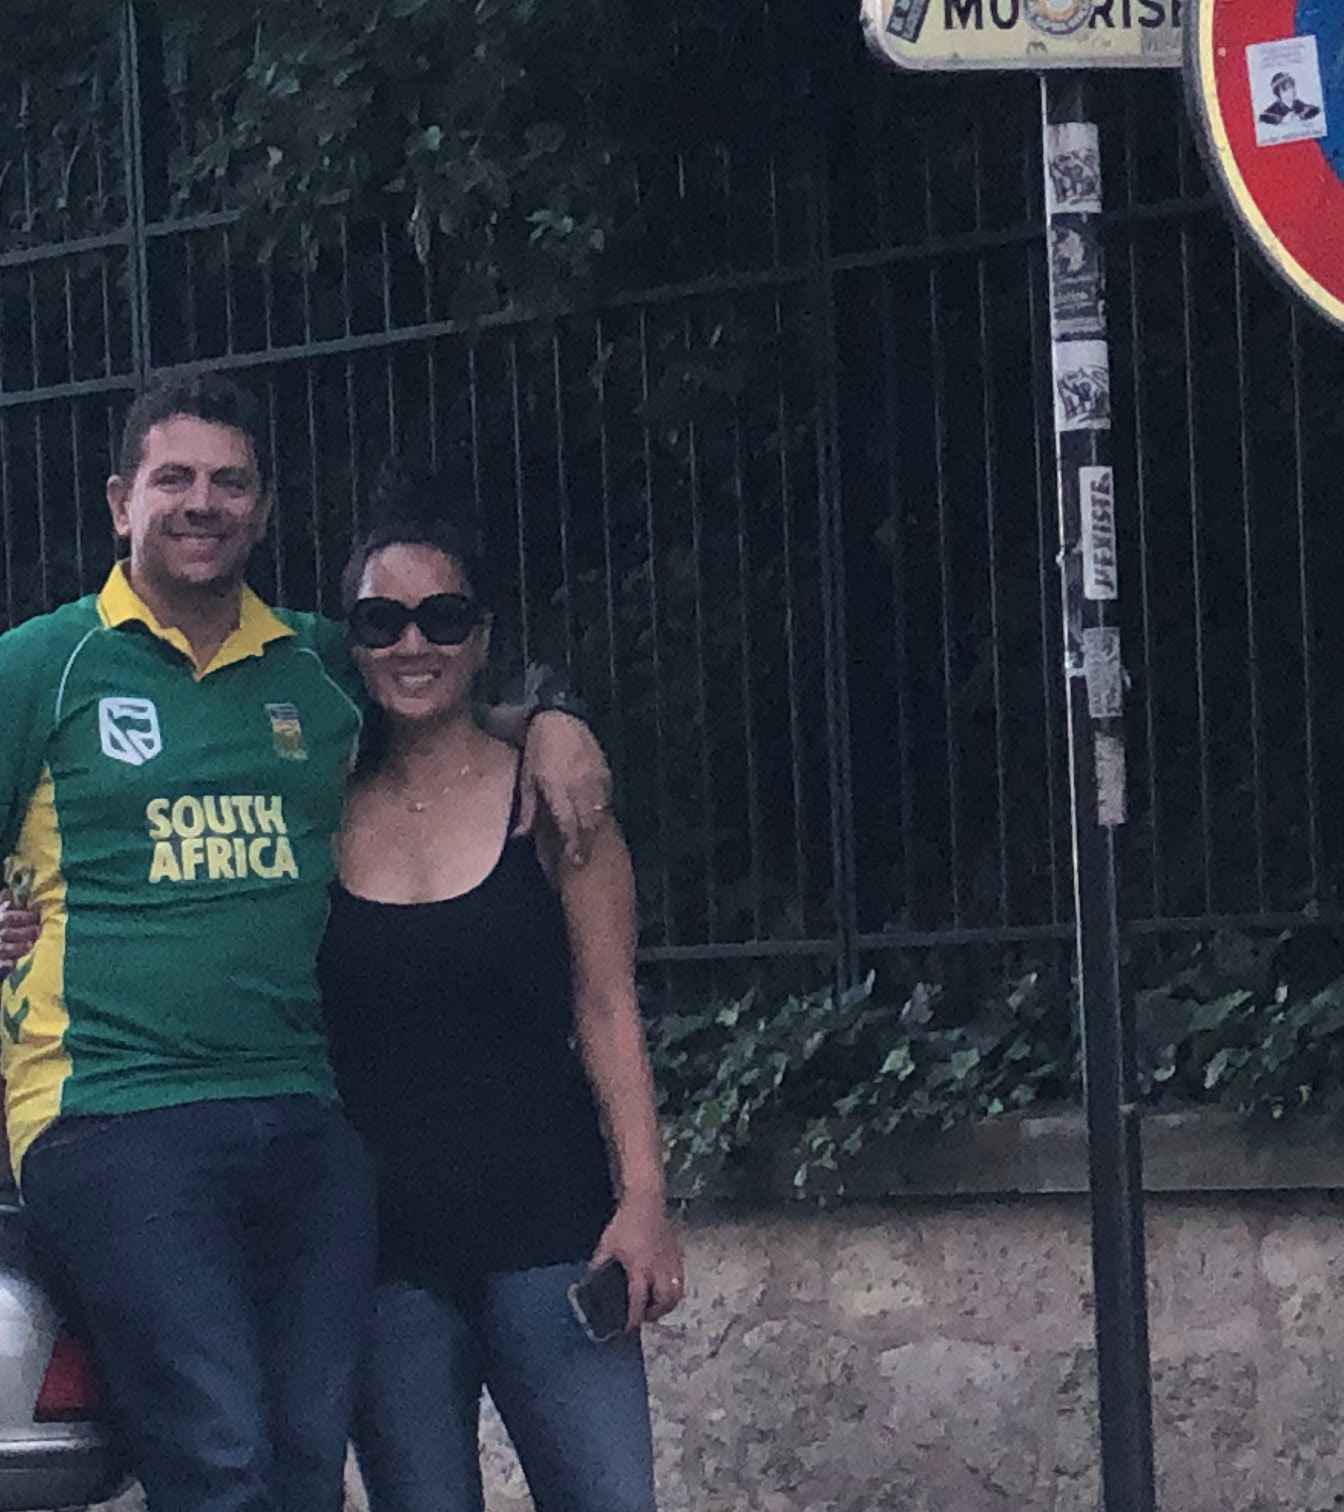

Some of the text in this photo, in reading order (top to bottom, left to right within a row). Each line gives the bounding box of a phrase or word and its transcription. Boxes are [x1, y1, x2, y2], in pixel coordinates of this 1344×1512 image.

[944, 0, 1181, 30] MORIS
[145, 795, 287, 839] SOUTH
[148, 836, 300, 883] AFRICA
